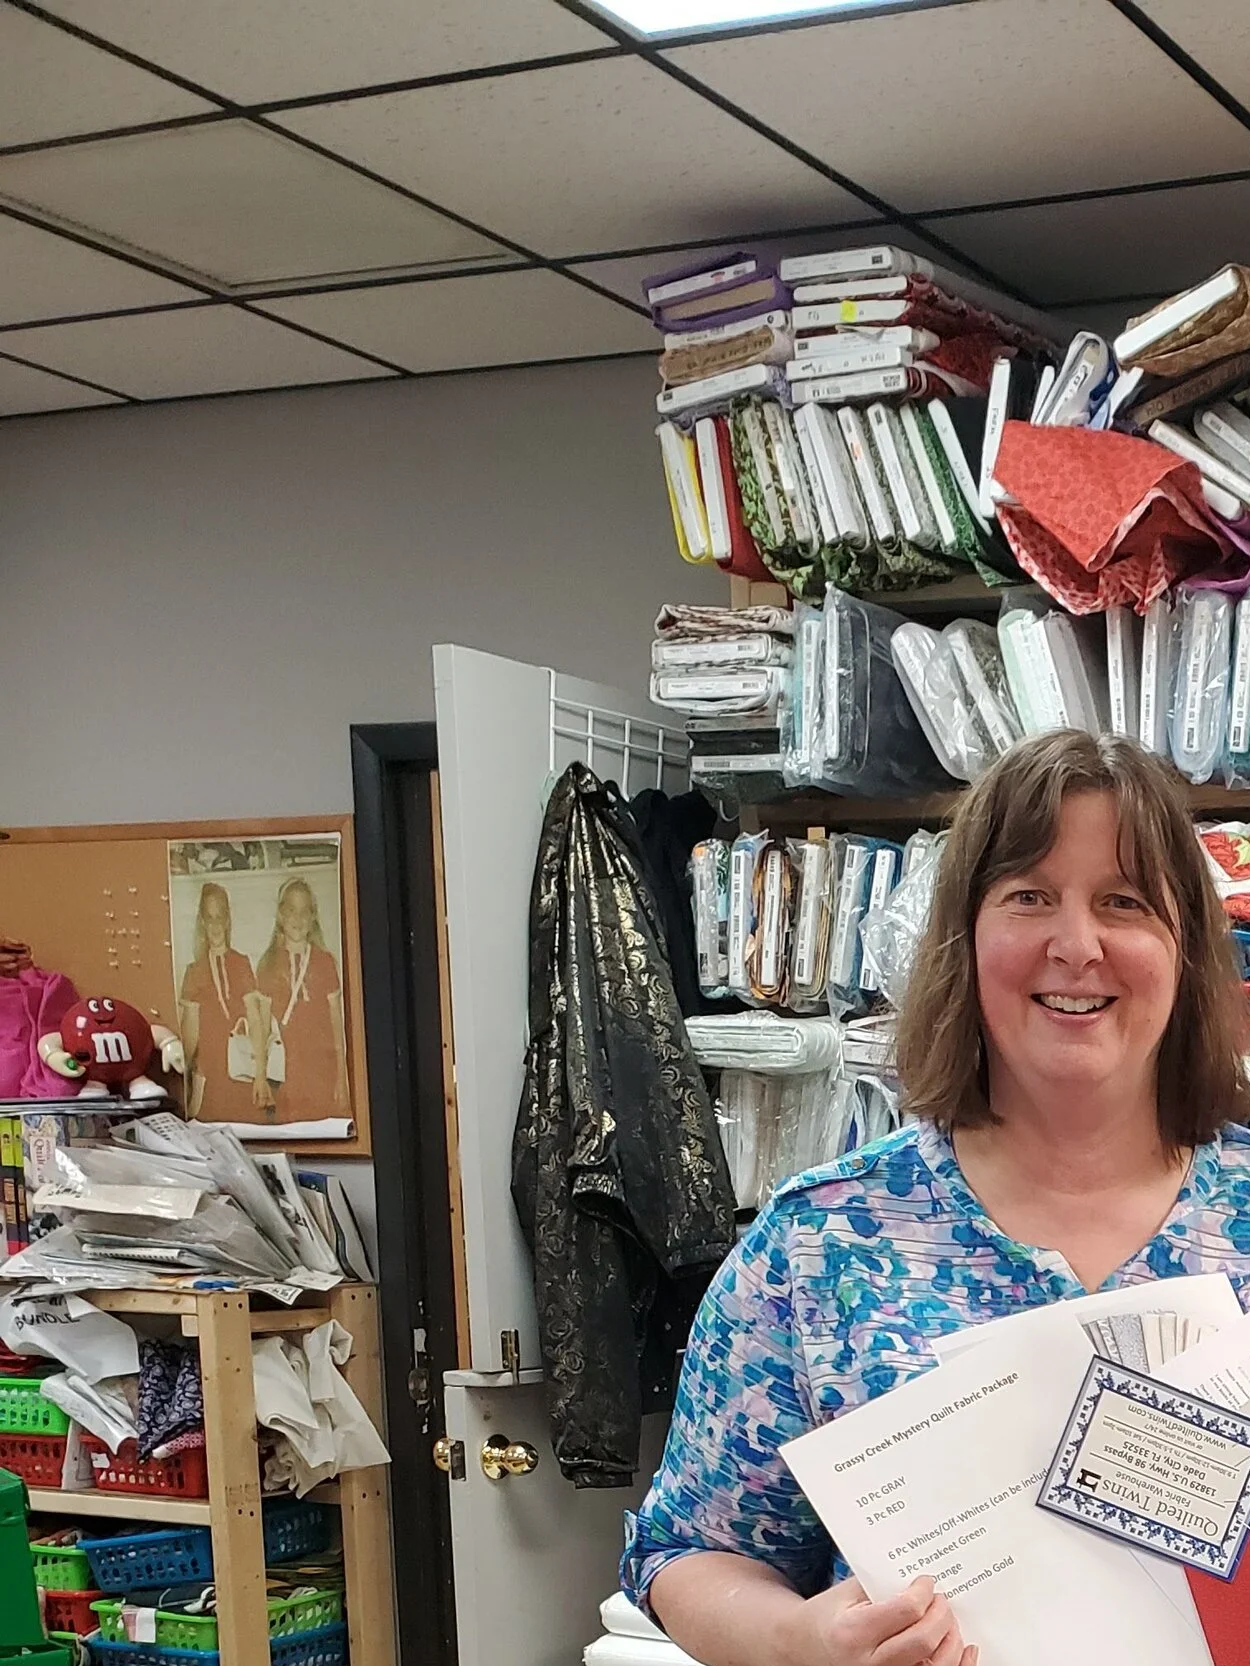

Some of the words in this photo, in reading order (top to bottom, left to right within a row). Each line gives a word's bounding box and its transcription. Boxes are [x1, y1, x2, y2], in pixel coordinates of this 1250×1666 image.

[91, 1031, 133, 1063] m
[15, 1313, 81, 1332] BUNDLE
[833, 1451, 866, 1474] Grassy
[865, 1438, 893, 1458] Creek
[892, 1418, 931, 1444] Mystery
[930, 1404, 955, 1424] Quilt
[953, 1391, 983, 1410] Fabric
[982, 1371, 1020, 1397] Package
[1127, 1404, 1227, 1450] www.QuiltedTwins.com
[1144, 1423, 1158, 1433] 24/7
[1103, 1444, 1134, 1463] Bypass
[1122, 1440, 1151, 1457] 33525
[1151, 1452, 1161, 1462] FL
[1134, 1459, 1147, 1469] 98
[1148, 1464, 1170, 1479] Hwy.
[1163, 1456, 1182, 1471] City,
[1182, 1464, 1206, 1480] Dade
[1115, 1470, 1164, 1497] Warehouse
[1170, 1474, 1188, 1486] U.S.
[1189, 1481, 1217, 1498] 13829
[855, 1495, 868, 1509] 10
[868, 1488, 881, 1501] Pc
[881, 1476, 907, 1495] GRAY
[1101, 1478, 1151, 1511] Twins
[1165, 1491, 1191, 1508] Fabric
[866, 1516, 875, 1527] 3
[874, 1507, 887, 1520] Pc
[886, 1500, 906, 1516] RED
[888, 1550, 896, 1561] 6
[896, 1544, 908, 1557] Pc
[906, 1501, 990, 1550] Whites/Off-Whites
[990, 1489, 1010, 1507] (can
[1010, 1483, 1022, 1495] be
[1156, 1500, 1219, 1537] Quilted
[898, 1568, 907, 1578] 3
[906, 1562, 919, 1575] Pc
[918, 1542, 960, 1567] Parakeet
[958, 1526, 988, 1546] Green
[992, 1555, 1015, 1573] Gold
